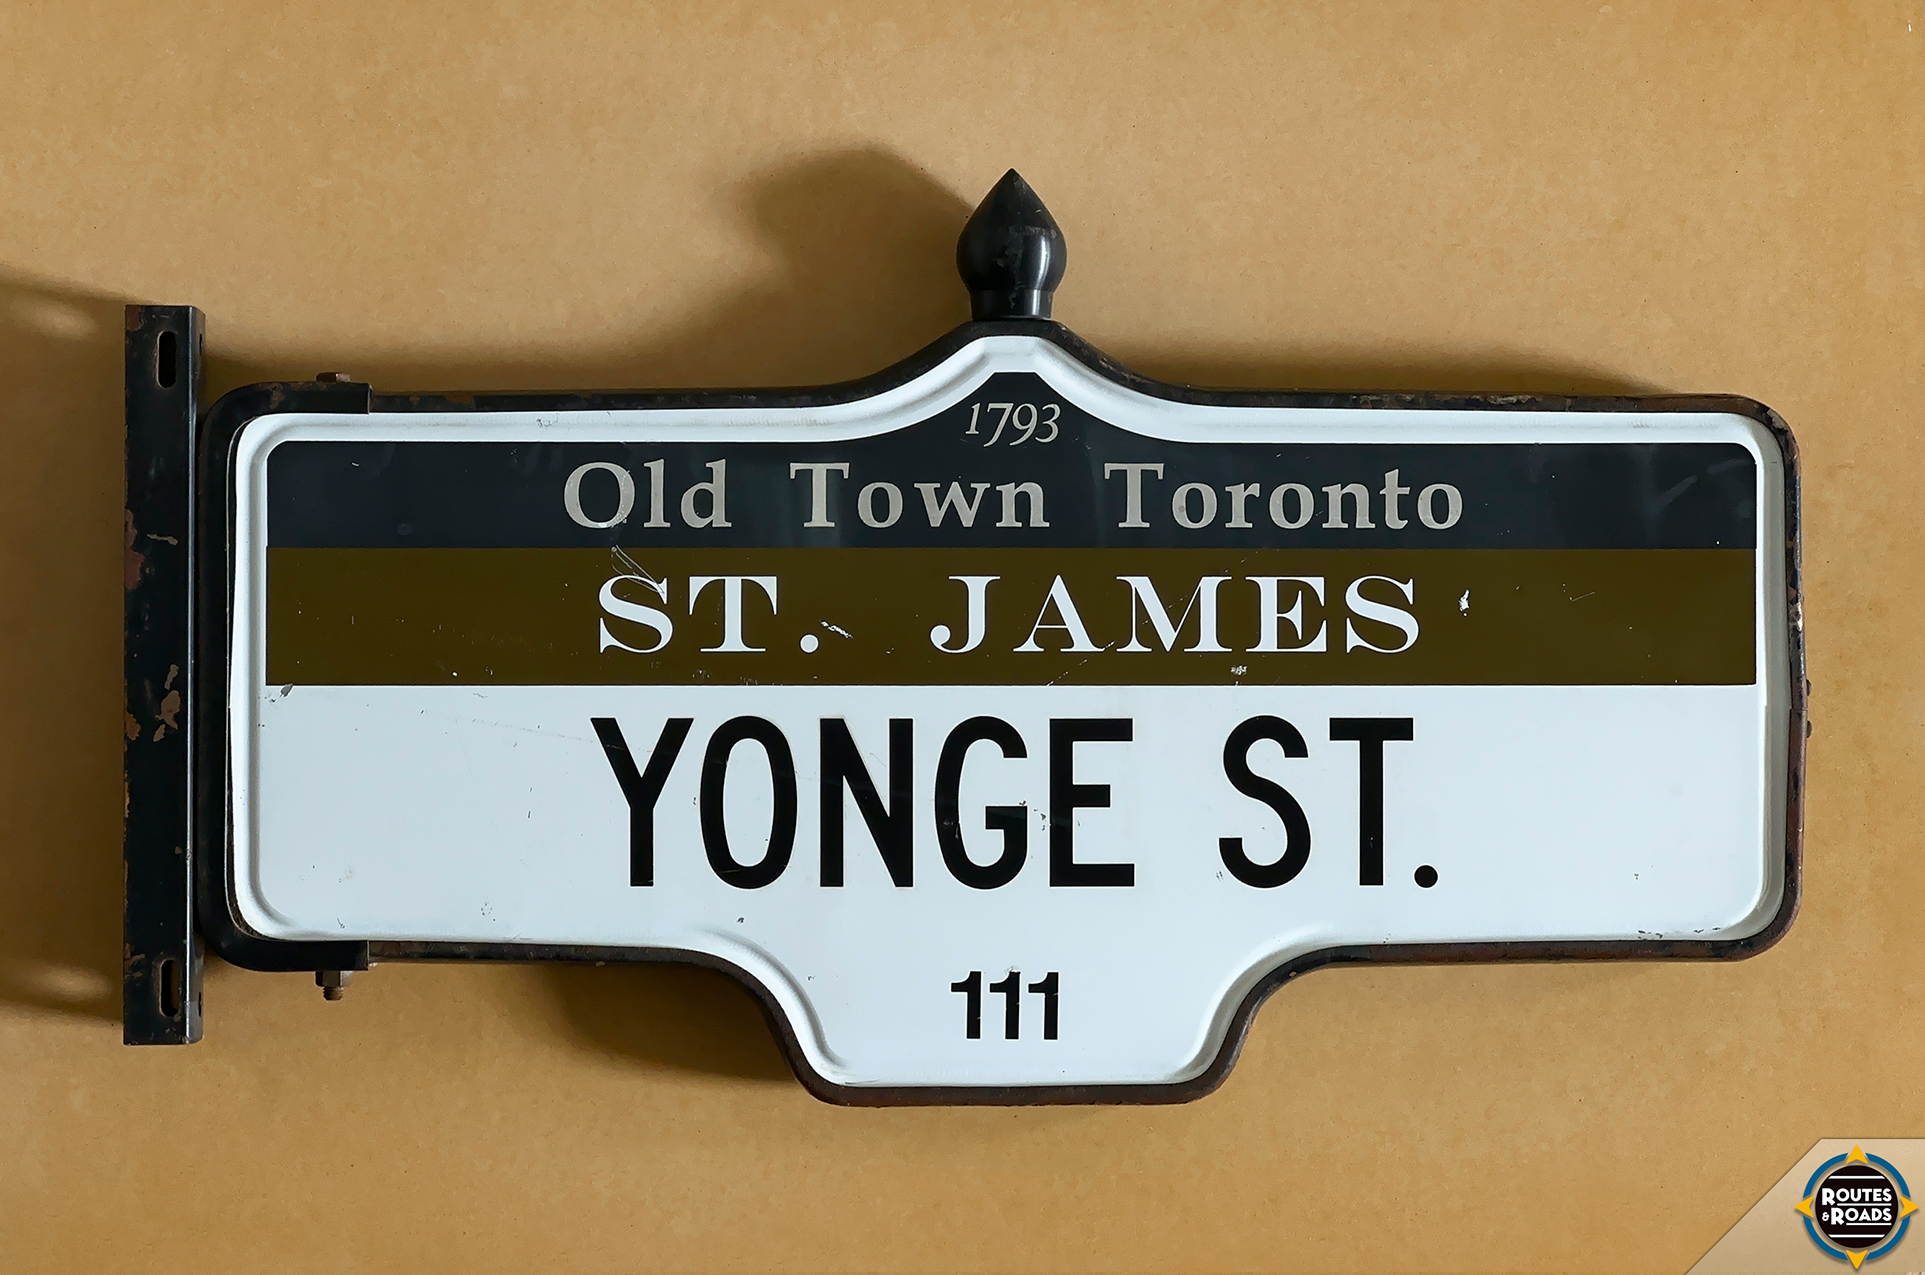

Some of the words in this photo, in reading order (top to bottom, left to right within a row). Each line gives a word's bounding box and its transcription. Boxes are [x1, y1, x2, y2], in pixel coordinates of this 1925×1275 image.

[965, 402, 1061, 448] 1793
[563, 461, 732, 530] Old
[789, 462, 1050, 529] Town
[1104, 462, 1463, 530] Toronto
[598, 574, 819, 654] ST.
[930, 575, 1419, 654] JAMES
[589, 716, 1135, 890] YONGE
[1218, 715, 1439, 889] ST.
[950, 970, 1059, 1041] 111
